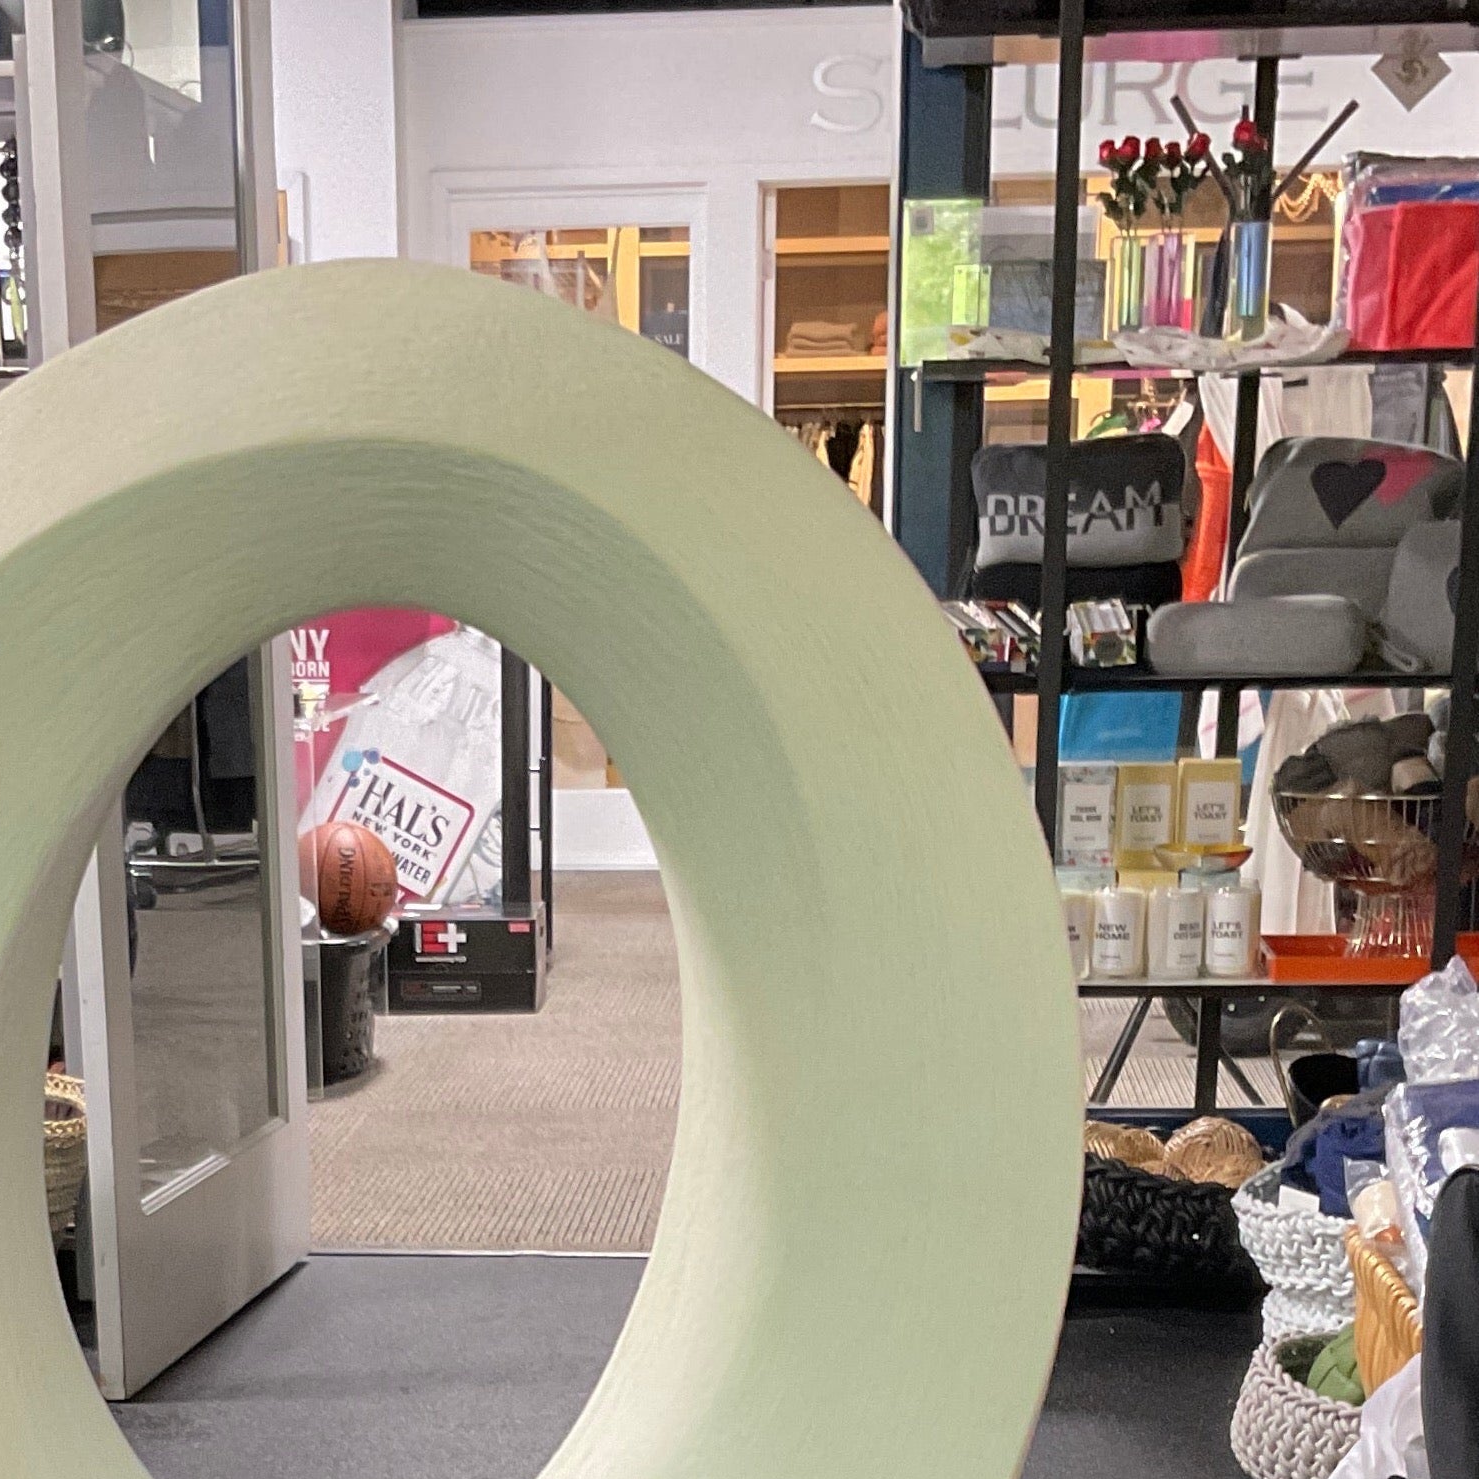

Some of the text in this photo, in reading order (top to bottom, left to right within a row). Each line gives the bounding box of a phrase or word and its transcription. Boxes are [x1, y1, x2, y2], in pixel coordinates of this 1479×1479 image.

[291, 661, 330, 677] ORN
[1132, 805, 1161, 813] LET'S
[1195, 802, 1225, 811] LET'S
[358, 775, 450, 848] HAL'S
[1193, 811, 1228, 820] TOAST
[1130, 814, 1163, 823] TOAST
[352, 811, 431, 860] NEW YORK
[1098, 923, 1127, 932] NEW
[1096, 932, 1130, 941] HOME
[1211, 930, 1243, 939] TOAST
